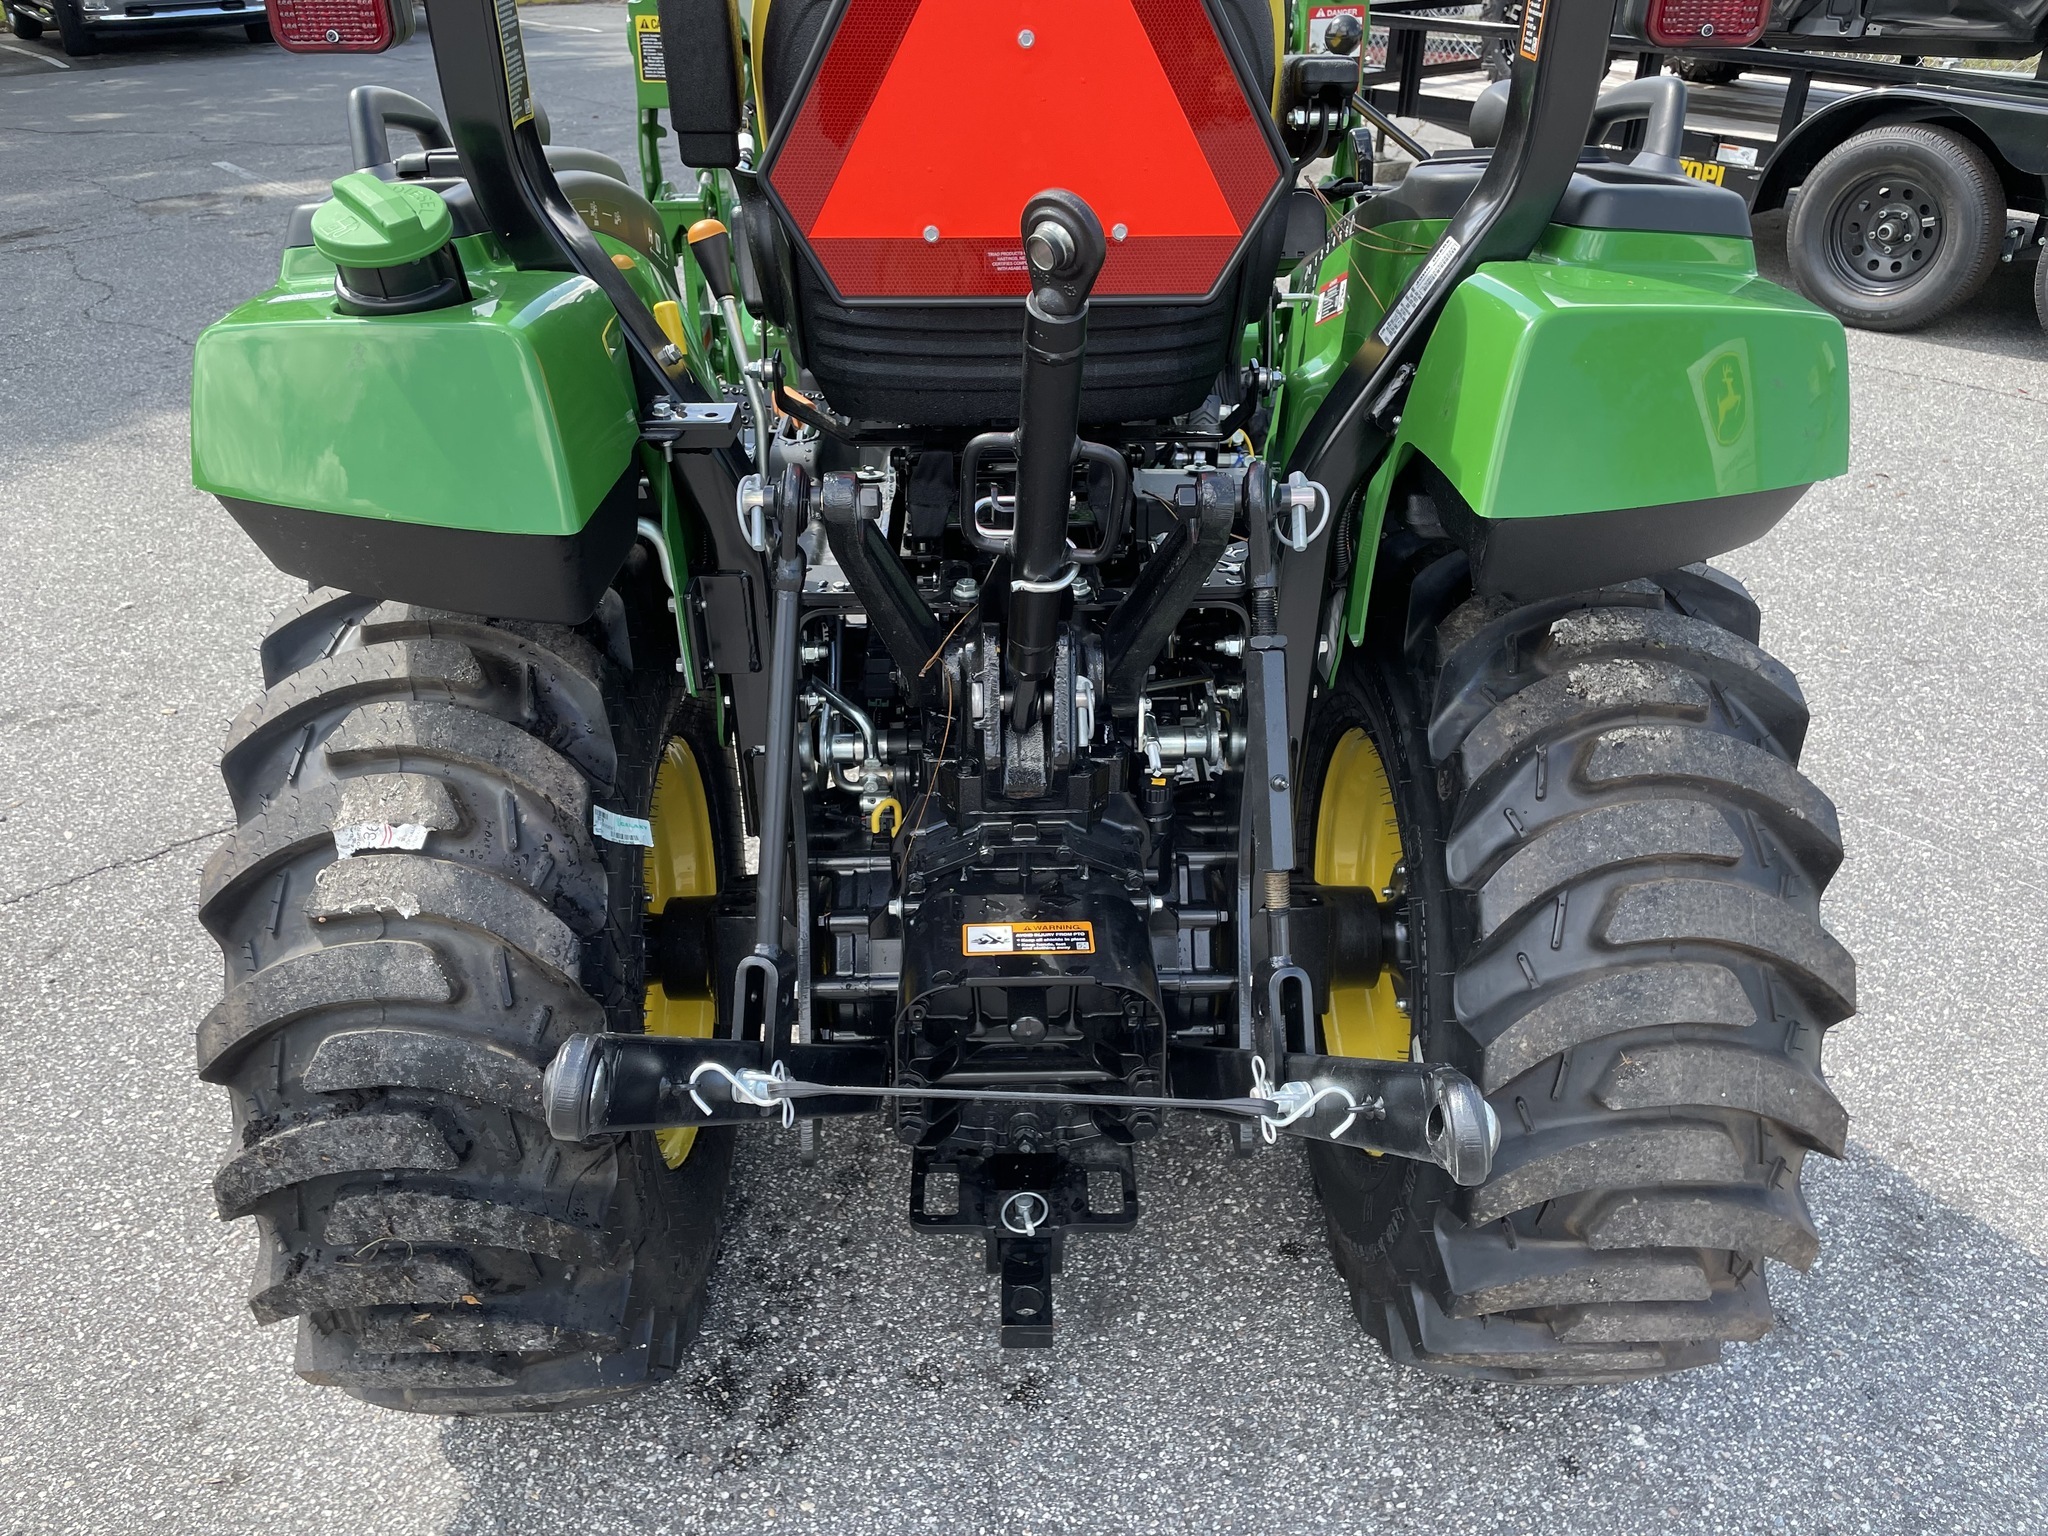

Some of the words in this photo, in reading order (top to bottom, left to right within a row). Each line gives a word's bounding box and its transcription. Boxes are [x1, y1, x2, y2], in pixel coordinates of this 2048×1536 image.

[1326, 8, 1358, 17] DANGER
[393, 186, 436, 215] DIESEL
[620, 821, 648, 830] GALAXY
